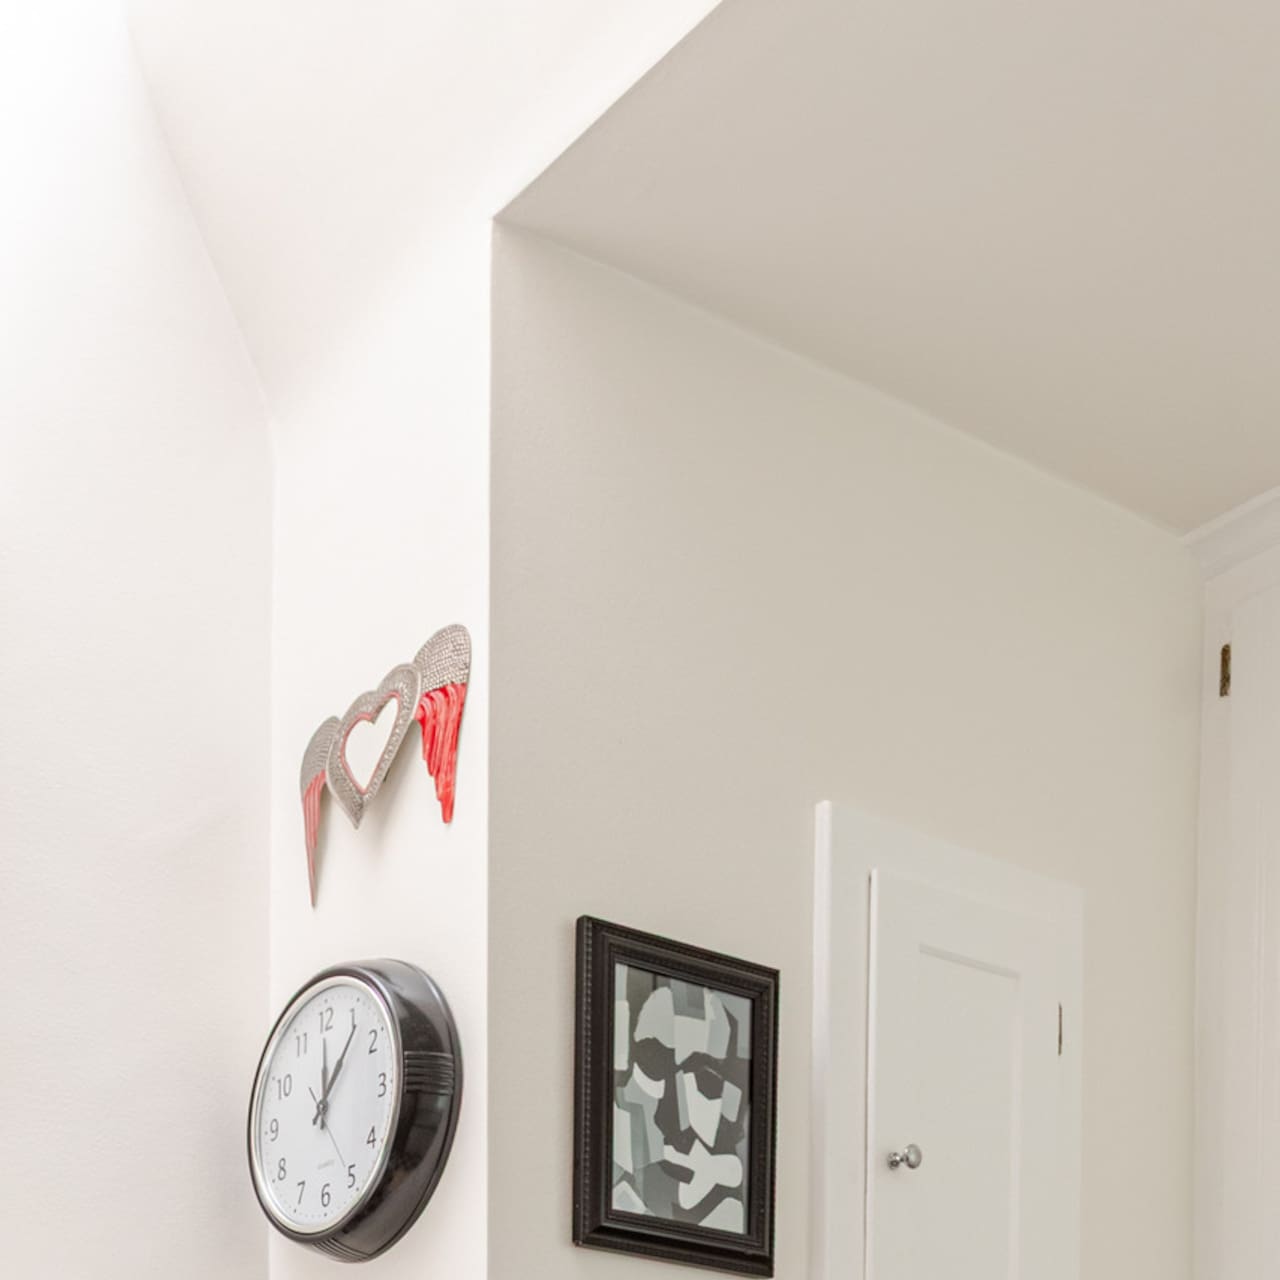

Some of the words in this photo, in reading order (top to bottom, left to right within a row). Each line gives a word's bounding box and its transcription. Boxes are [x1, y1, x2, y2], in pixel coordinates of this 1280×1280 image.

[319, 1007, 334, 1034] 12
[295, 1033, 308, 1057] 11
[368, 1030, 378, 1054] 2
[276, 1073, 292, 1100] 10
[378, 1073, 387, 1098] 3
[269, 1119, 279, 1141] 9
[366, 1126, 376, 1149] 4
[277, 1158, 287, 1181] 8
[347, 1164, 356, 1188] 5
[297, 1181, 305, 1206] 7
[321, 1183, 331, 1208] 6
